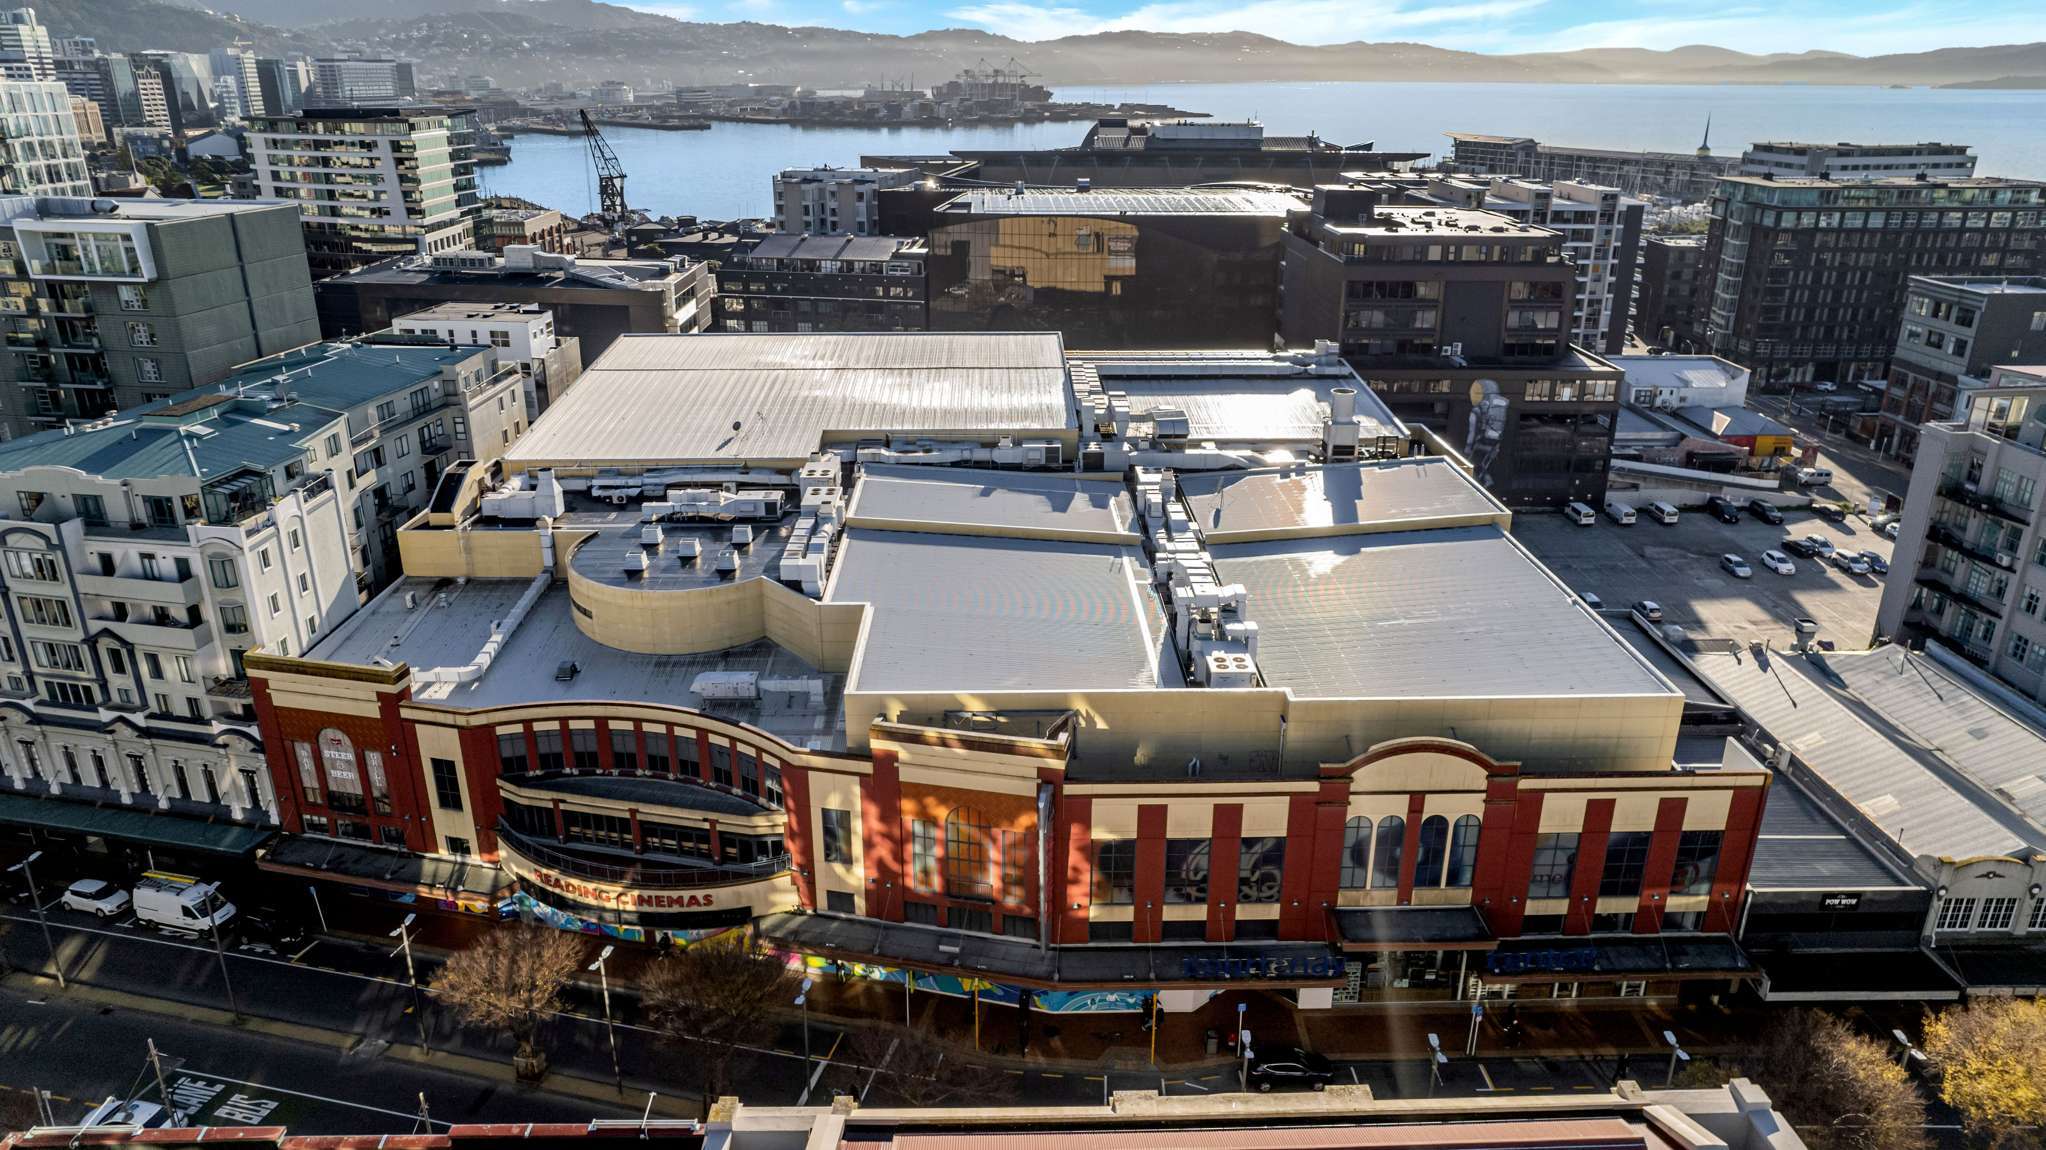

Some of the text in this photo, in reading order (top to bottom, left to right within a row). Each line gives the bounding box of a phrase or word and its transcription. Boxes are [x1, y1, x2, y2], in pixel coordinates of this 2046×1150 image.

[323, 750, 354, 761] STEER
[330, 769, 355, 780] BEER
[534, 868, 715, 909] READING CINEMAS
[166, 1076, 227, 1116] LANE
[213, 1093, 280, 1126] BUS
